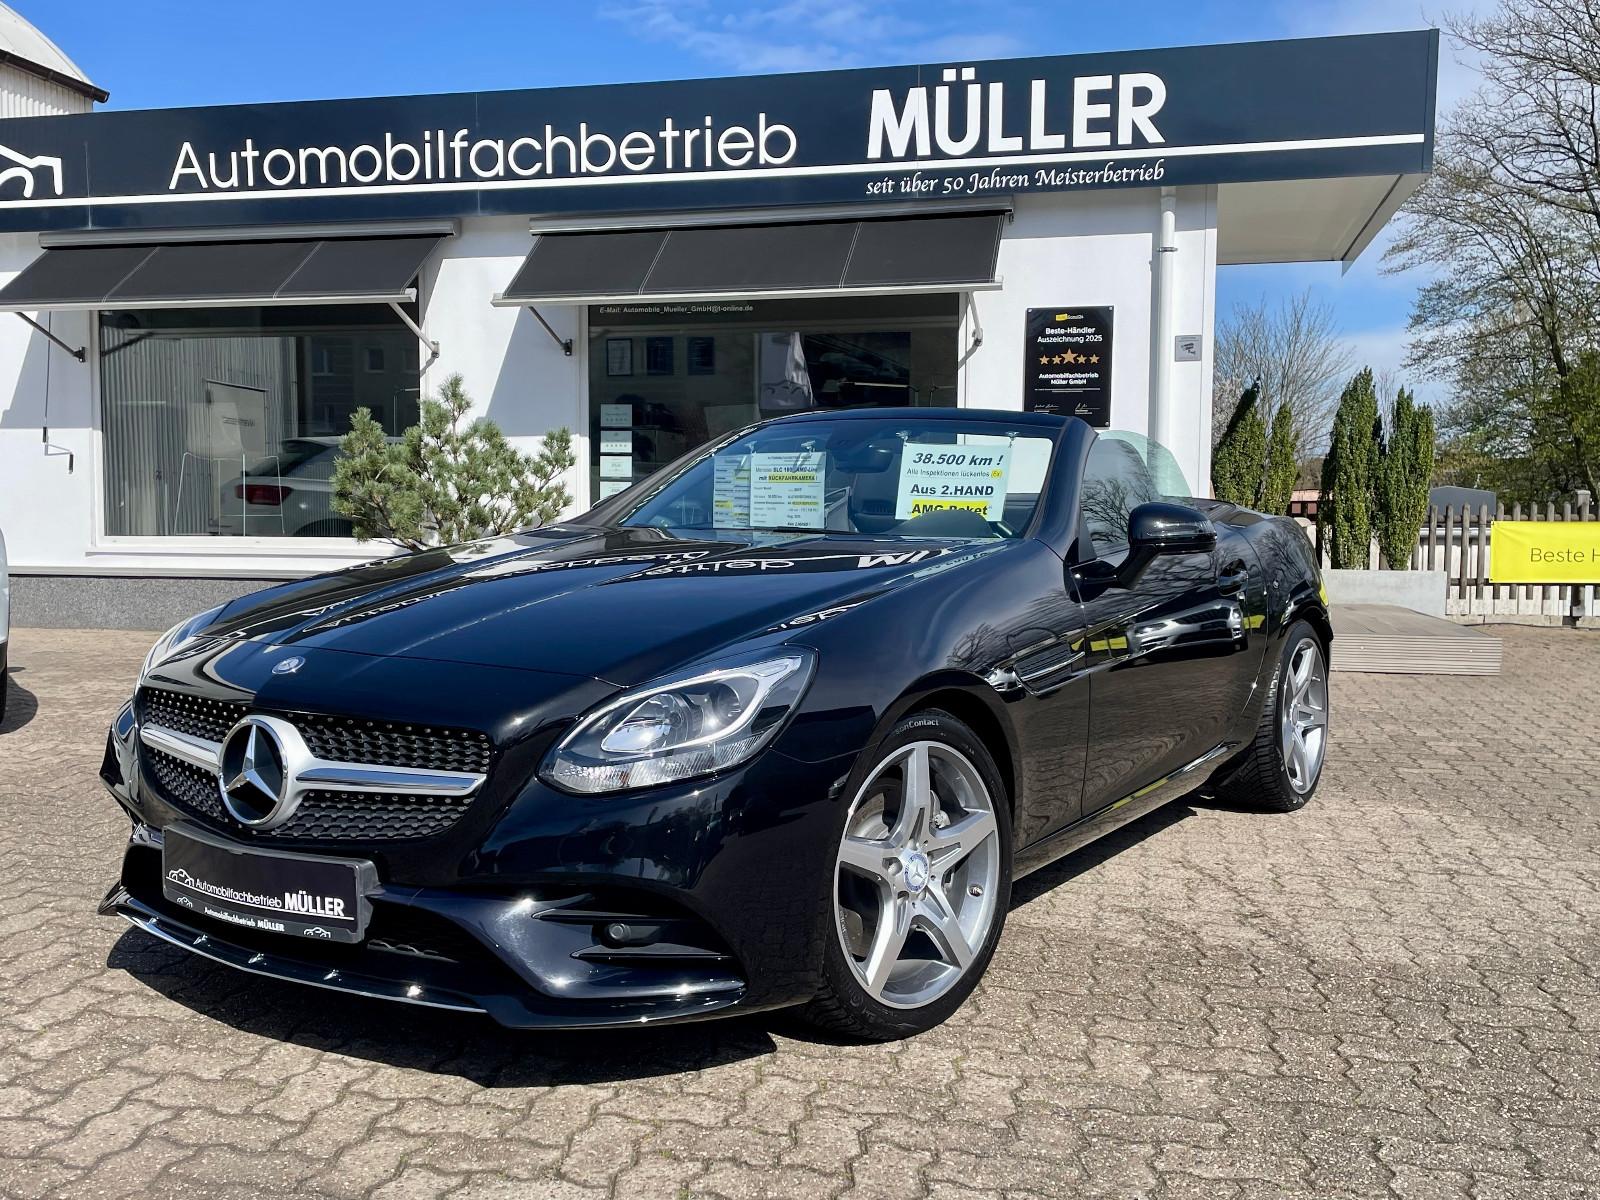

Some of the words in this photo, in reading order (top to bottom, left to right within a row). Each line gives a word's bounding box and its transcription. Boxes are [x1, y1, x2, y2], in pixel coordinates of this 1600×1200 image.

[168, 113, 798, 191] Automobilfachbetrieb
[866, 67, 1167, 160] MÜLLER
[866, 177, 895, 194] seit
[900, 172, 938, 192] über
[942, 176, 964, 193] 50
[966, 168, 1029, 194] Jahren
[1035, 159, 1164, 186] Meisterbetrieb
[913, 453, 966, 466] 38.500
[969, 455, 993, 466] km
[997, 455, 1004, 466] !
[920, 469, 959, 478] Inspektionen
[910, 484, 936, 495] Aus
[941, 485, 994, 496] 2.HAND
[1530, 547, 1585, 563] Beste
[195, 878, 282, 908] Automobilfachbetrieb
[284, 890, 345, 917] MÜLLER
[257, 919, 285, 932] MÜLLER
